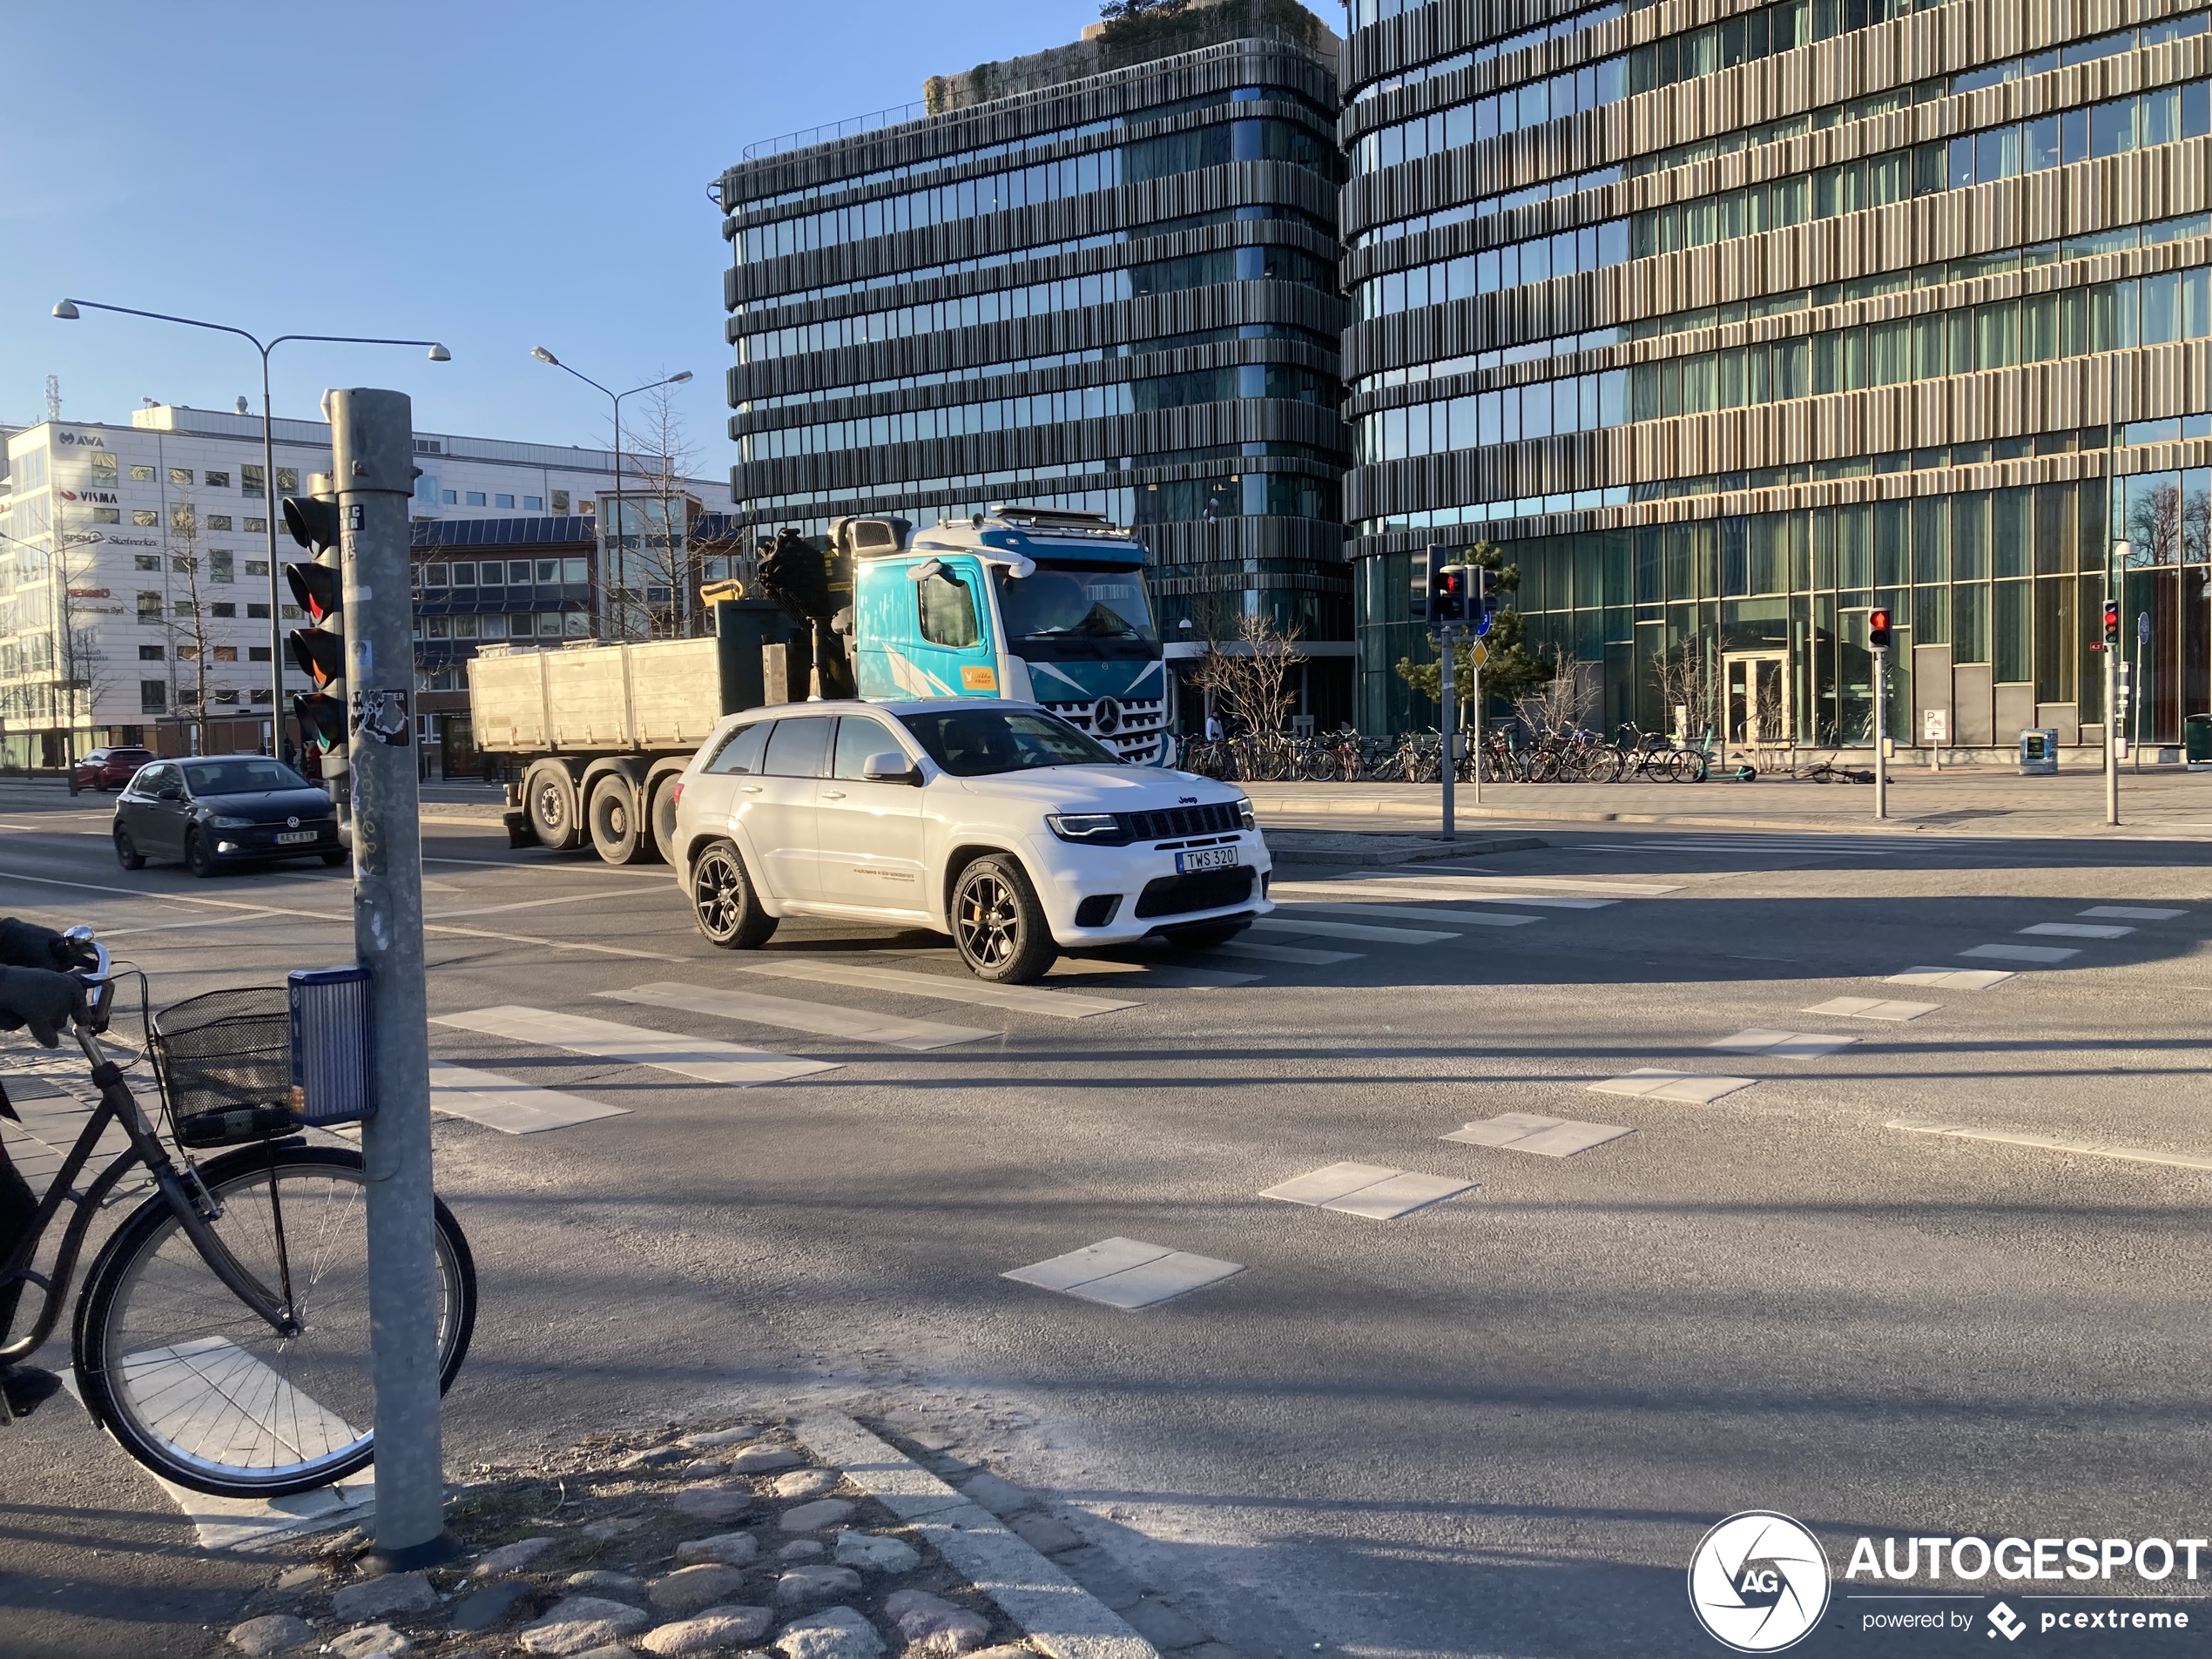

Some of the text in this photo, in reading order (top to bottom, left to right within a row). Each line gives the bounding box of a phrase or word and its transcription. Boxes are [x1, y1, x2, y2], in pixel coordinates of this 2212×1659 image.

[76, 435, 105, 448] AWA
[80, 491, 118, 504] VISMA
[64, 534, 91, 543] SPSM
[1927, 711, 1935, 722] P
[1187, 849, 1233, 868] TWS 320
